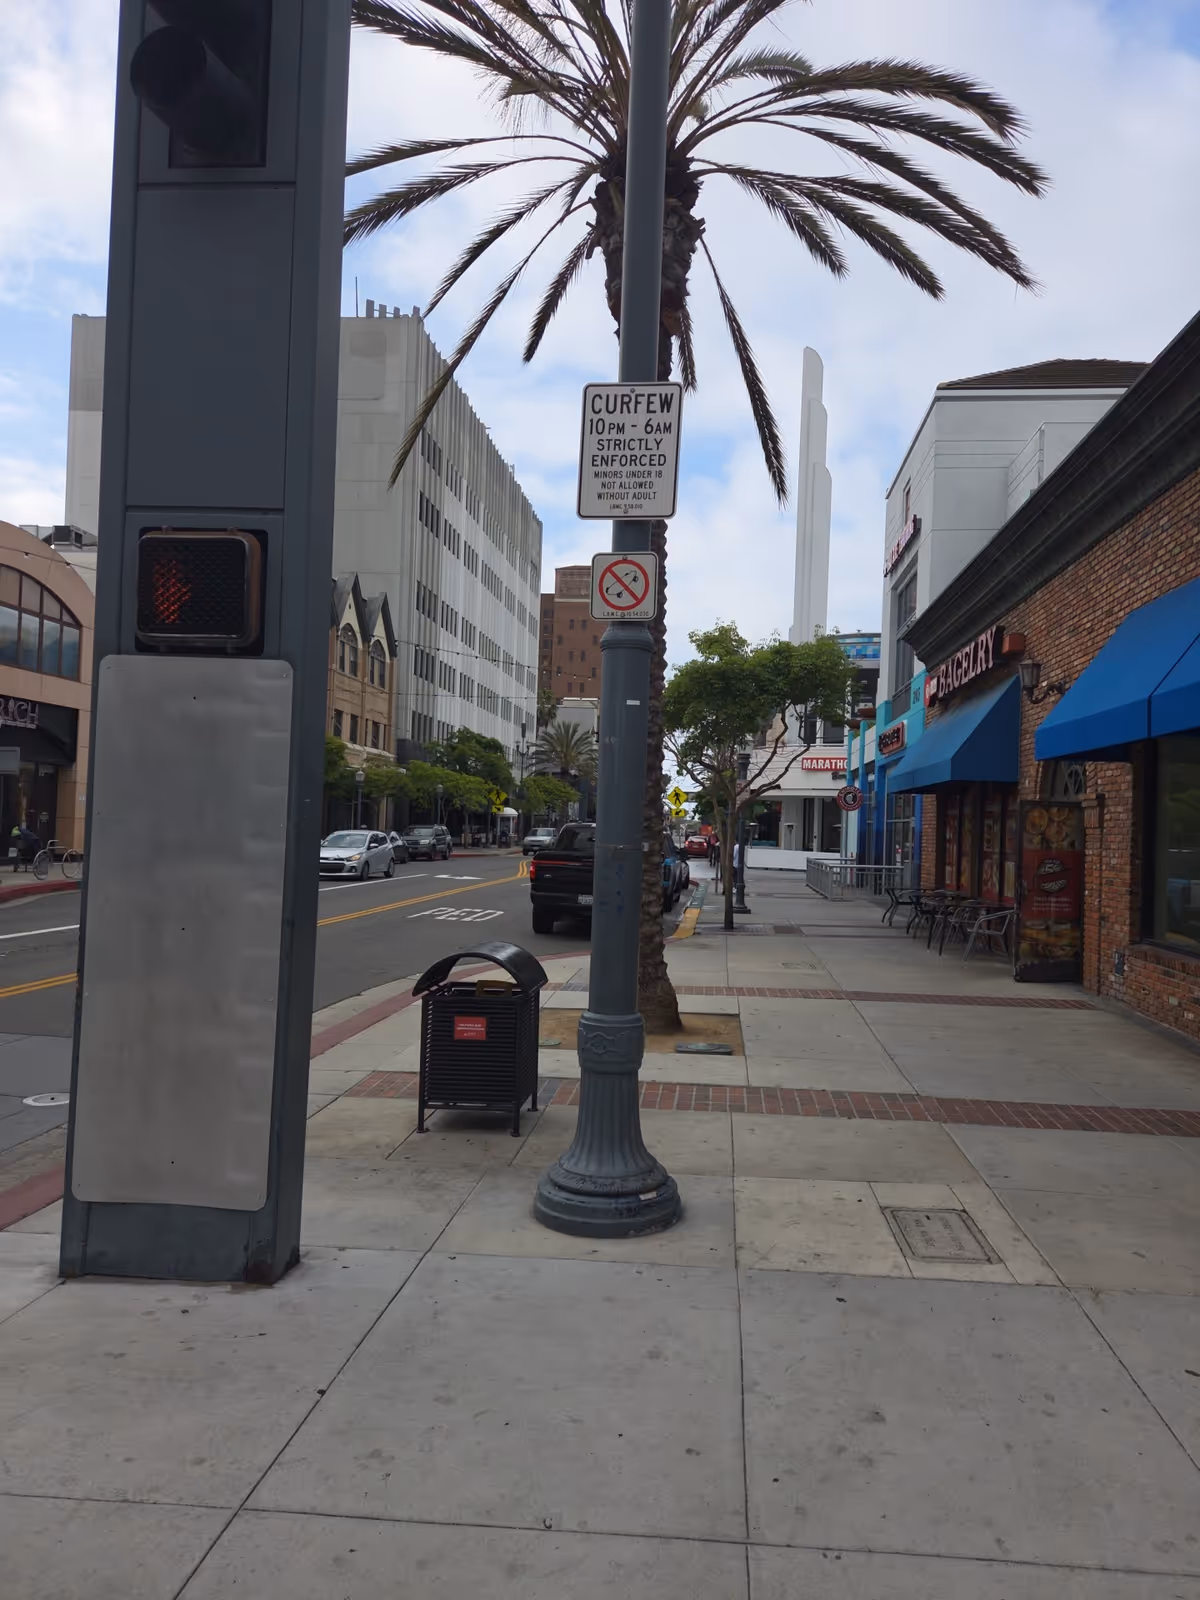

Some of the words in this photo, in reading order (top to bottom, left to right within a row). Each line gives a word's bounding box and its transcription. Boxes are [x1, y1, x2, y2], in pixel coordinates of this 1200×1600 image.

[591, 392, 674, 415] CURFEW
[644, 417, 672, 435] 6AM
[596, 438, 663, 452] STRICTLY
[591, 453, 667, 467] ENFORCED
[594, 470, 623, 479] MINORS
[626, 470, 652, 479] UNDER
[655, 469, 663, 479] 18
[601, 481, 616, 490] NOT
[618, 481, 654, 490] ALLOWED
[597, 492, 630, 500] WITHOUT
[632, 491, 657, 500] ADULT
[938, 625, 997, 698] BAGELRY
[407, 907, 504, 922] PED
